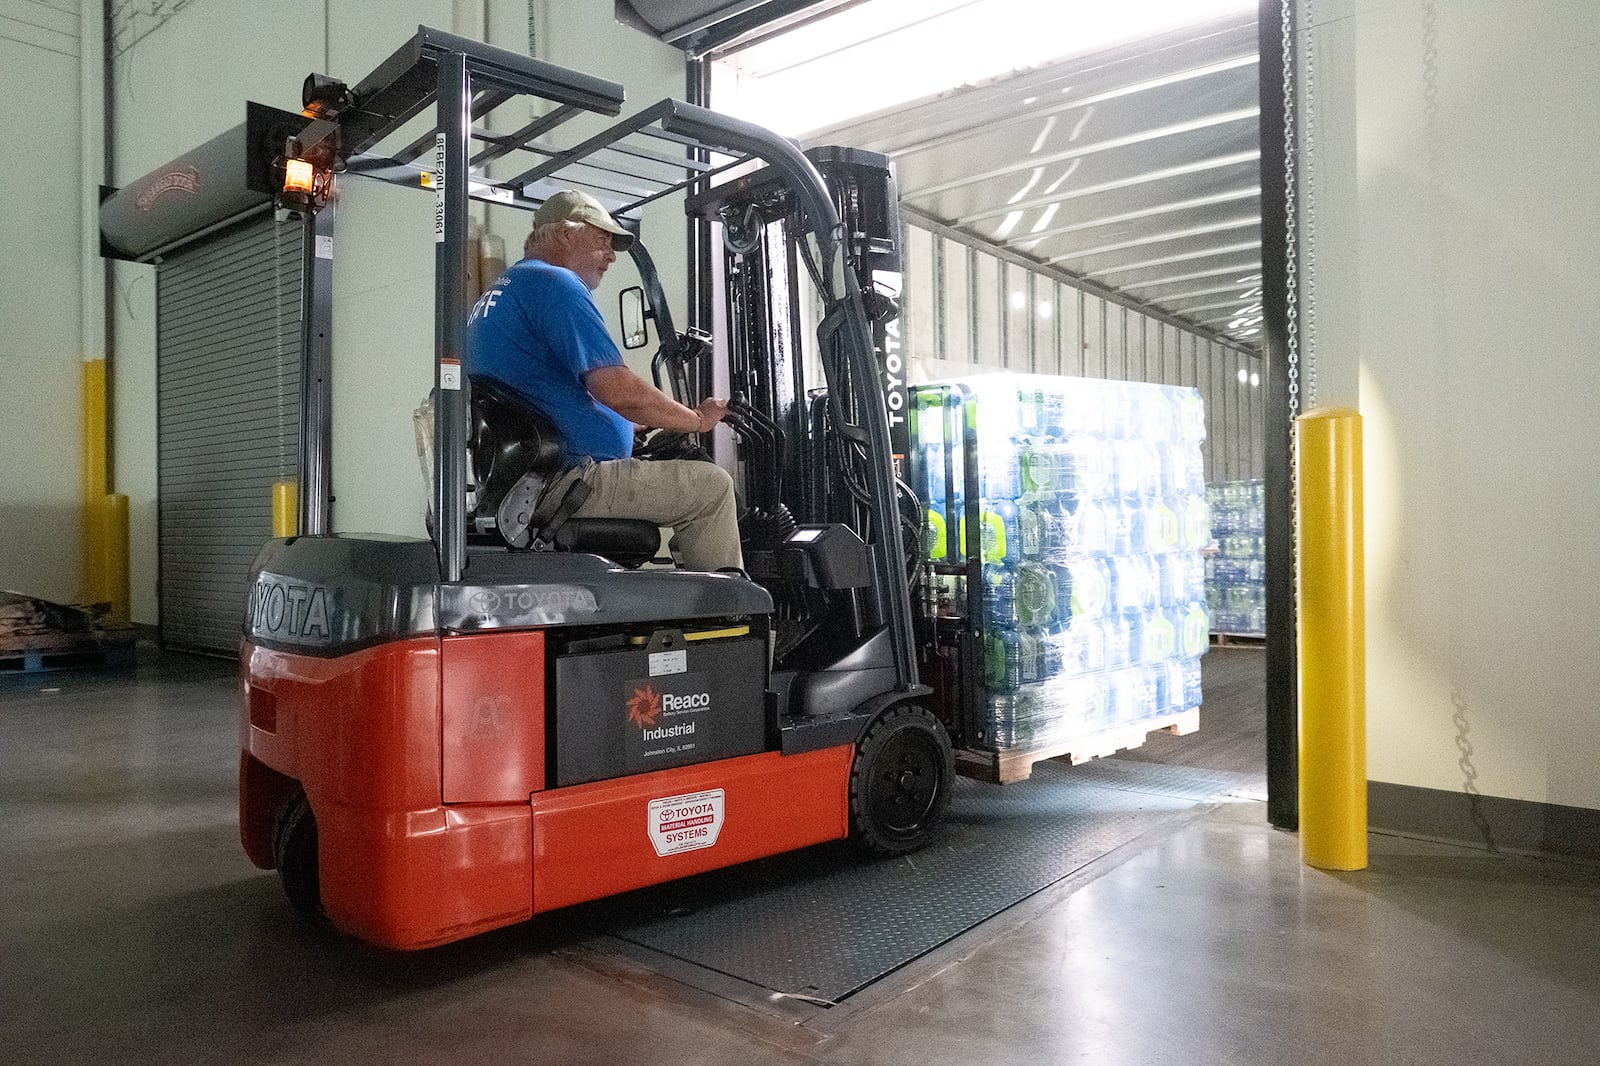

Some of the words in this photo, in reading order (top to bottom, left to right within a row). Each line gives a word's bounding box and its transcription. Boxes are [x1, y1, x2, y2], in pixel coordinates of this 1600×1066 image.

[885, 318, 904, 428] TOYOTA
[504, 590, 588, 611] TOYOTA
[662, 693, 710, 711] Reaco
[643, 721, 695, 740] Industrial
[675, 803, 714, 818] TOYOTA
[661, 820, 687, 831] MATERIAL
[686, 816, 713, 827] HANDLING
[666, 827, 708, 843] SYSTEMS
